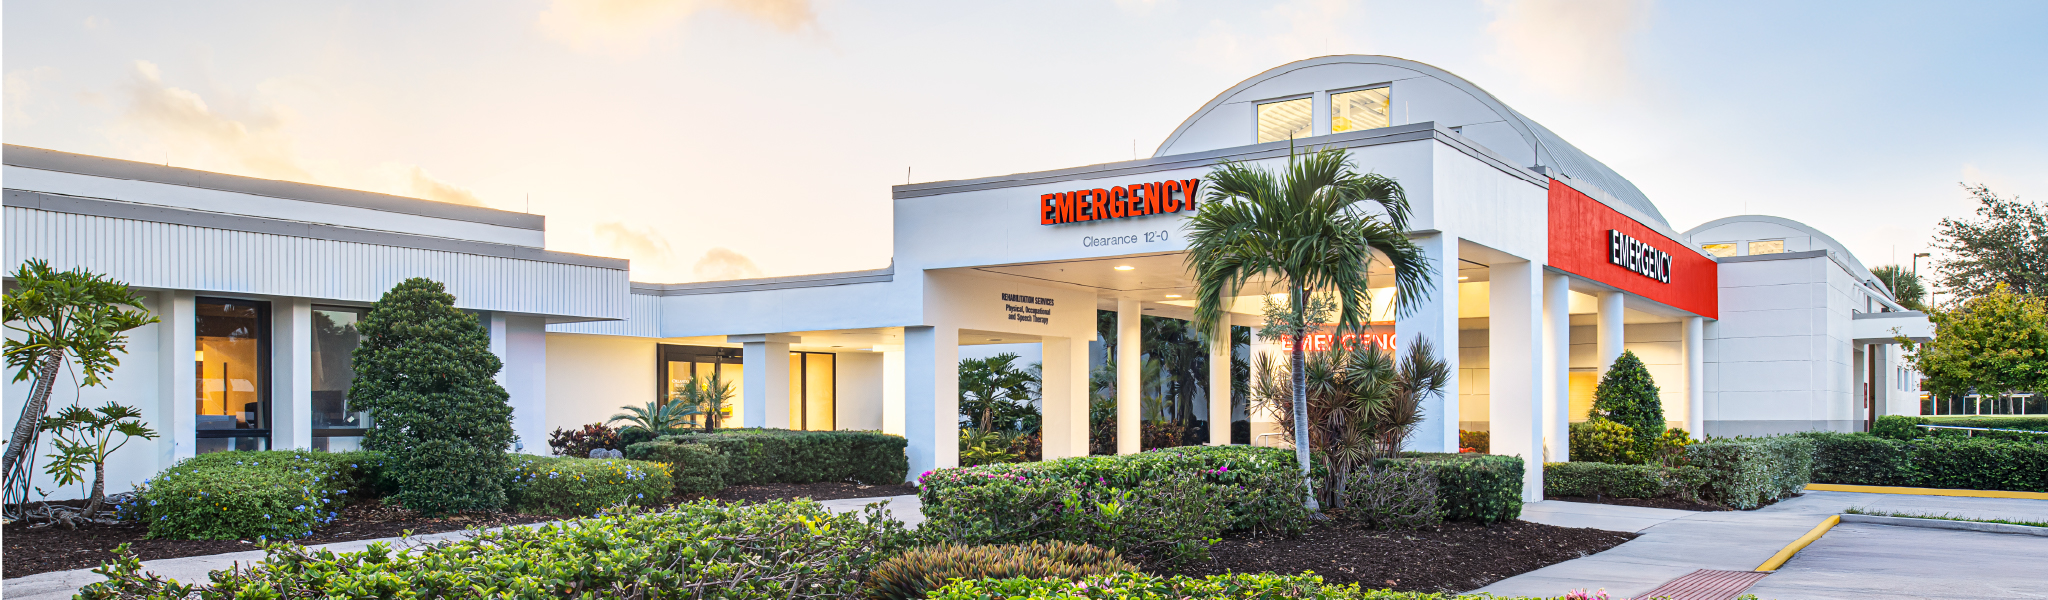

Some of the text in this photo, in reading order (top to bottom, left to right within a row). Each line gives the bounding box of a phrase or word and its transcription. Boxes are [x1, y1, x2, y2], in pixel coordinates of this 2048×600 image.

[1040, 178, 1199, 225] EMERGENCY
[1082, 234, 1138, 247] Clearance
[1610, 229, 1673, 284] EMERGENCY
[1001, 292, 1055, 307] REHABILITATION SERVICES
[1005, 303, 1051, 316] Physical, Occupational
[1016, 313, 1032, 323] Speech
[1032, 314, 1049, 325] Therapy
